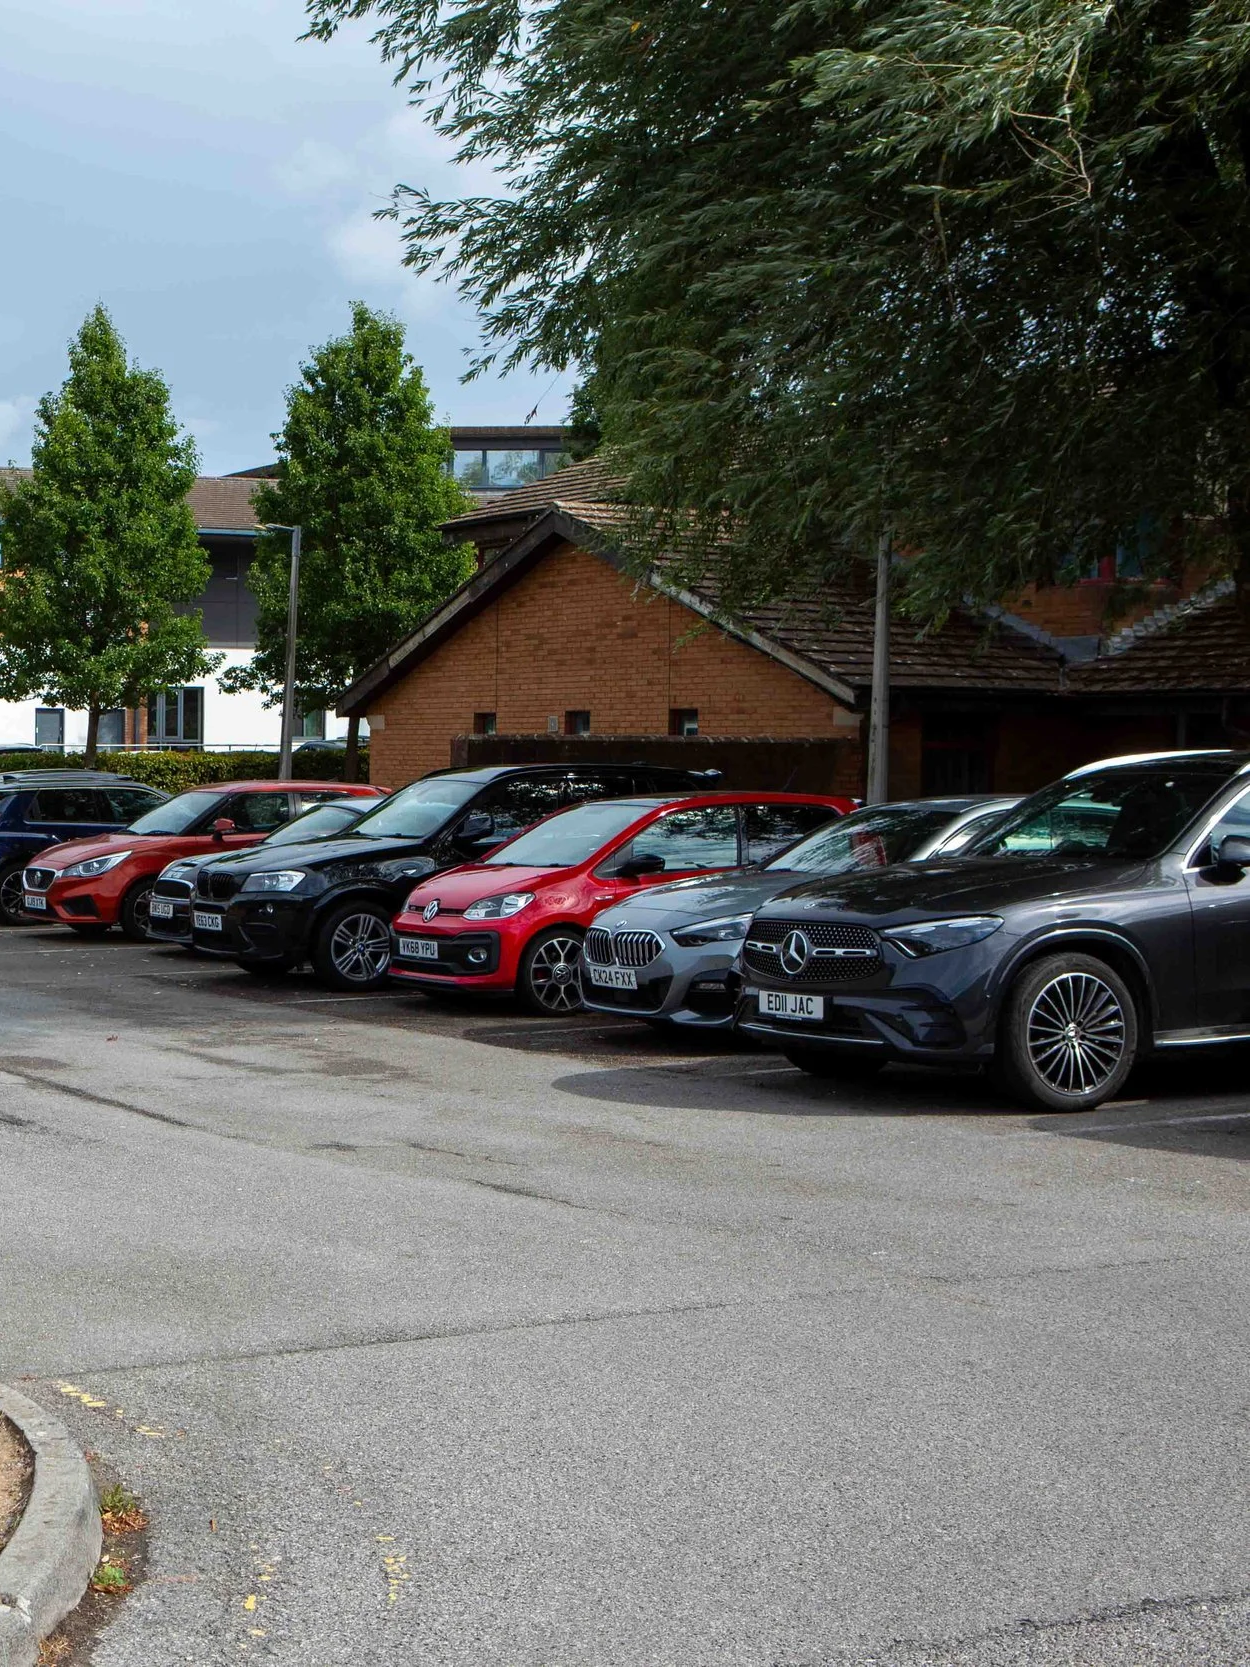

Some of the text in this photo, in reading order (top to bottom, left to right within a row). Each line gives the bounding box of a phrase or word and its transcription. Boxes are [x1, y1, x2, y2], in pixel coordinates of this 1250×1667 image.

[402, 940, 435, 956] VK68 YPU
[593, 969, 633, 987] CK24 FXX
[791, 996, 813, 1015] JAC
